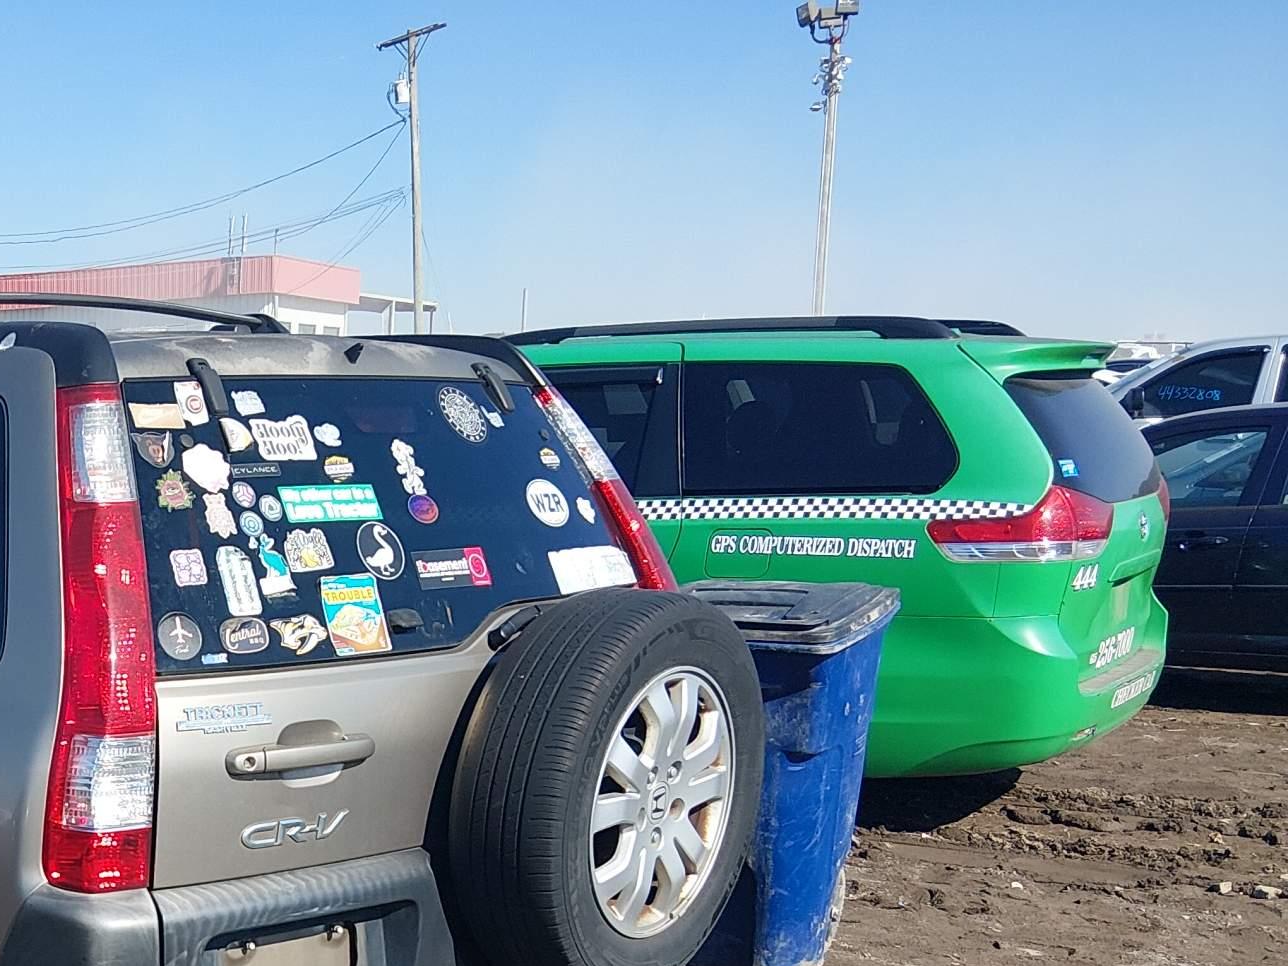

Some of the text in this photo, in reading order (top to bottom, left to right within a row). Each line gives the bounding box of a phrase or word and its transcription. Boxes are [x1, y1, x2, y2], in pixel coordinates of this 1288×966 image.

[234, 466, 278, 475] CYLANCE
[530, 492, 565, 513] WZR
[712, 536, 916, 558] GPS COMPUTERIZED DISPATCH
[1072, 563, 1099, 591] 444
[324, 588, 373, 602] TROUBLE
[226, 624, 261, 649] Central
[241, 808, 350, 849] CR-V
